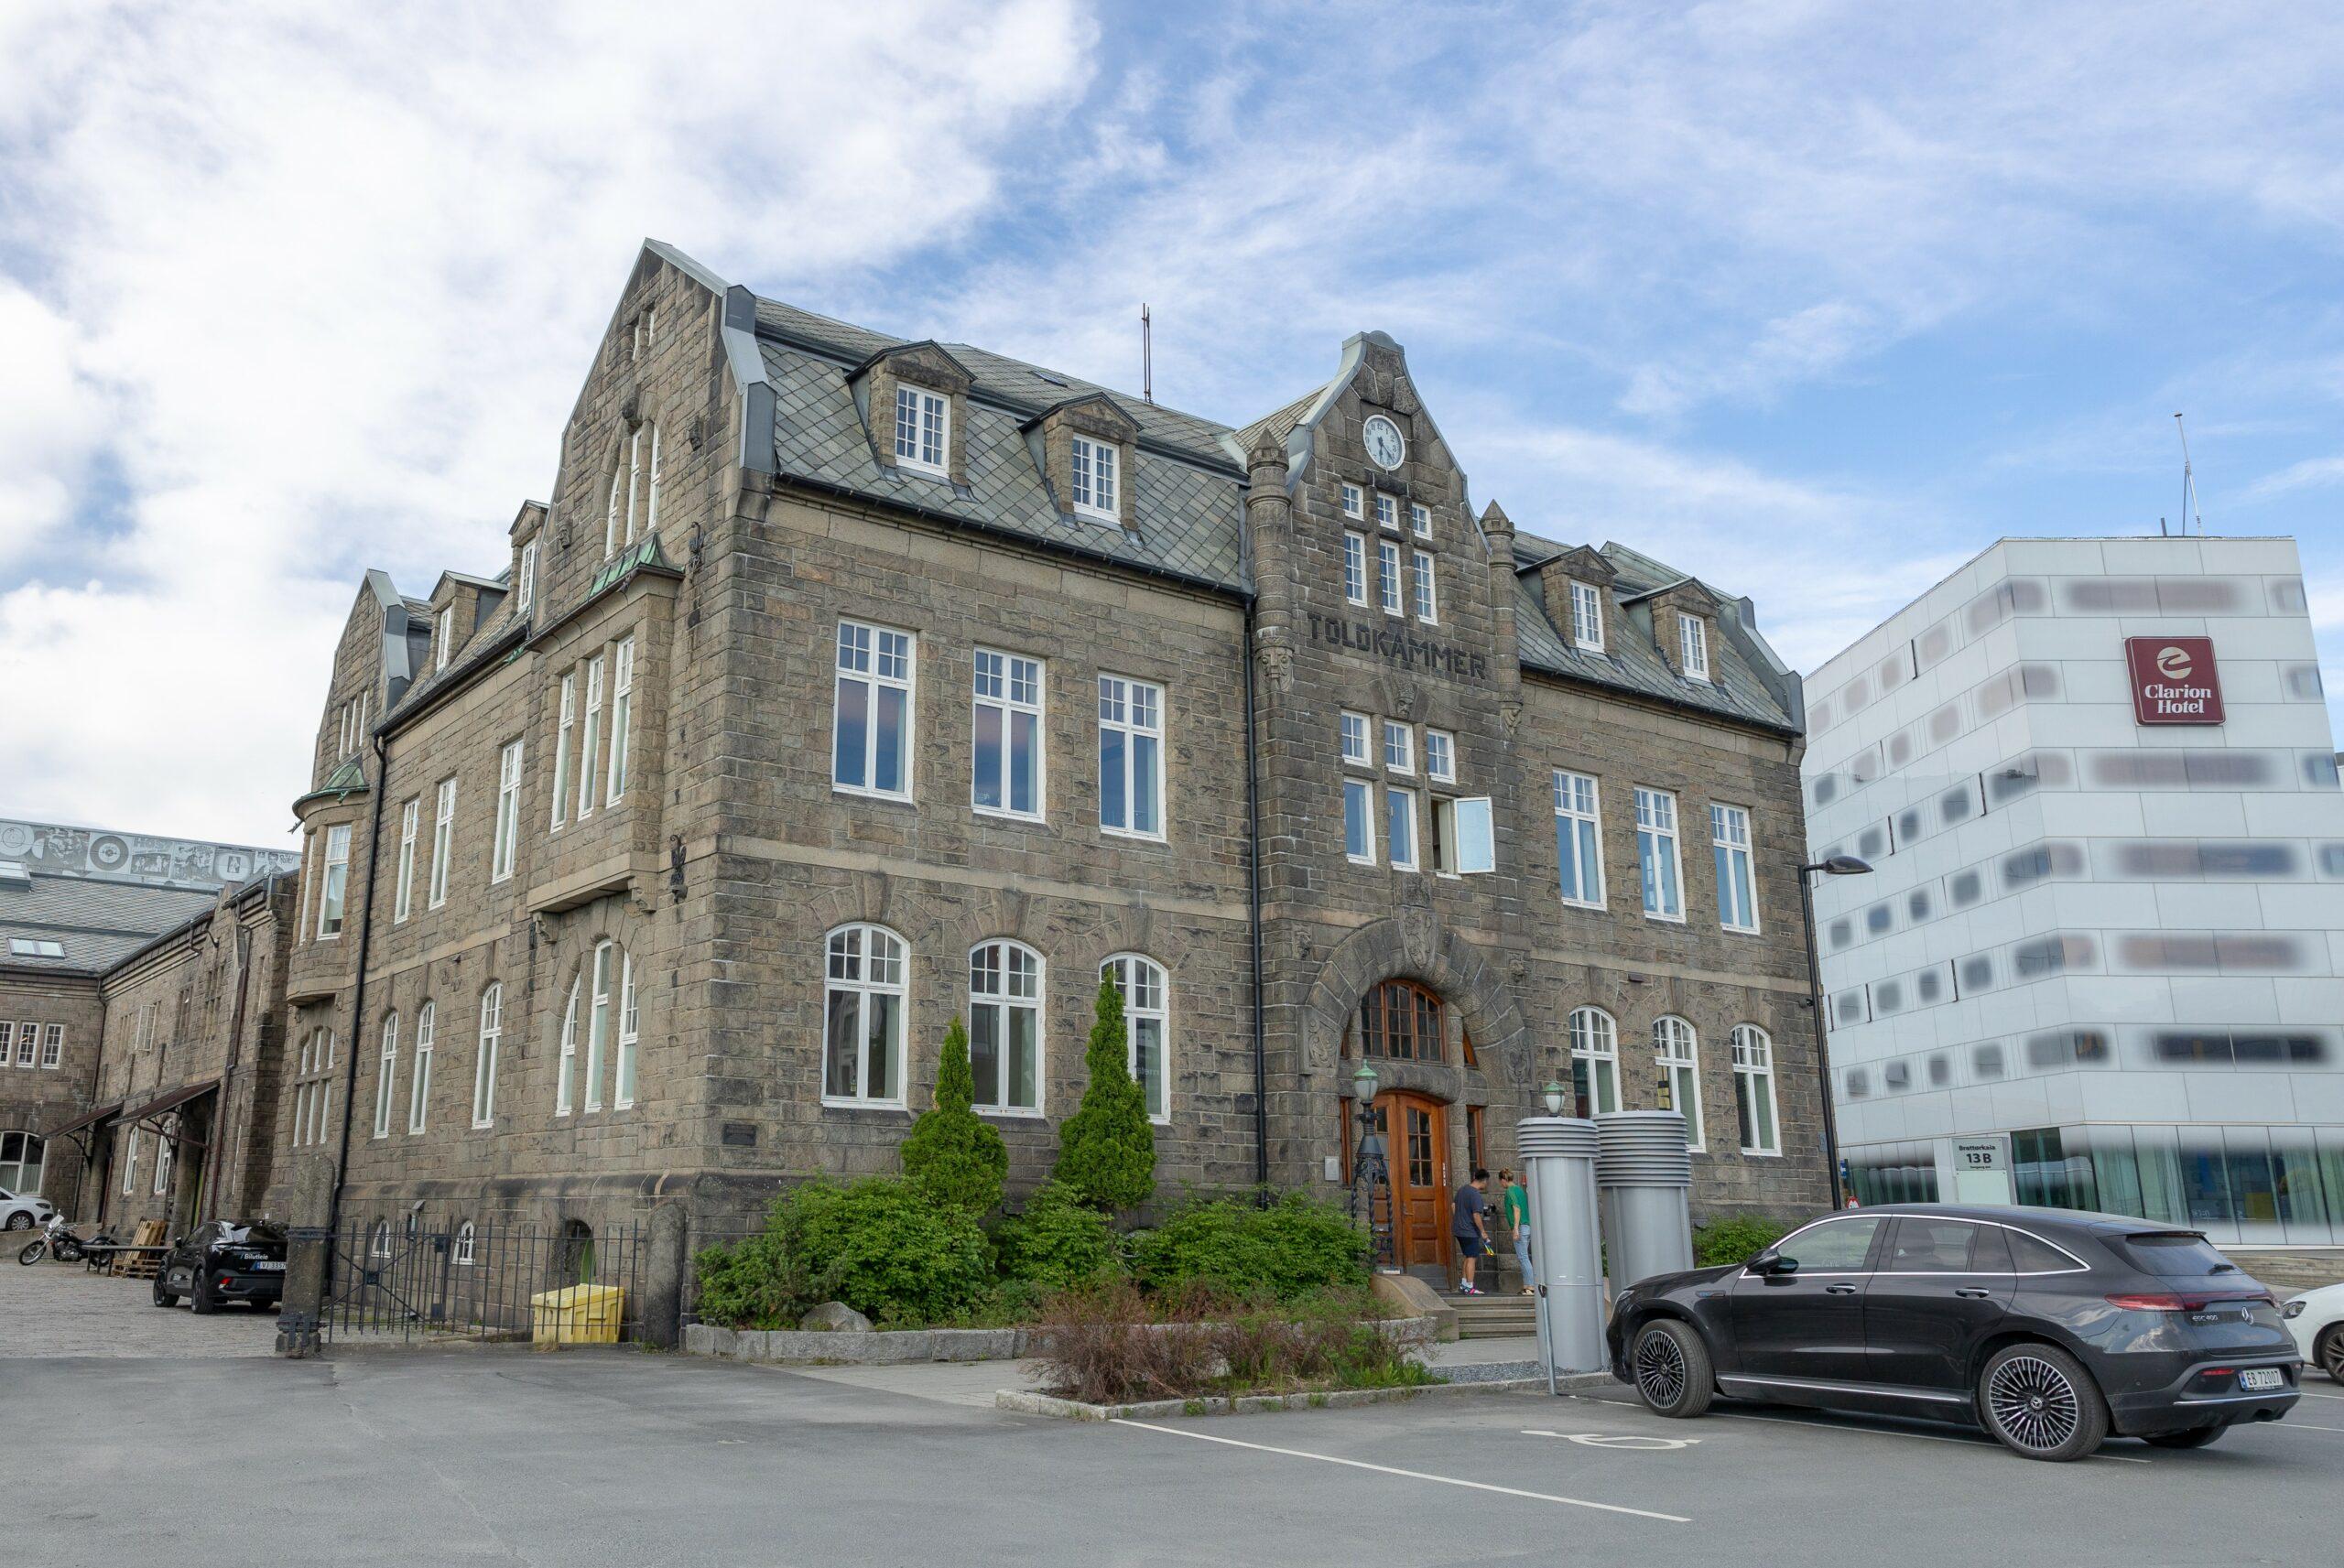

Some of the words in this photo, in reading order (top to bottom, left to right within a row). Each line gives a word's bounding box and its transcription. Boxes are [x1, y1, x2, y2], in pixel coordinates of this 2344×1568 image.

[1307, 611, 1487, 680] TOLDKAMMER
[2144, 684, 2212, 698] Clarion
[2157, 698, 2205, 714] Hotel
[1966, 1152, 1981, 1163] 13
[1982, 1152, 1992, 1163] B
[2245, 1371, 2257, 1386] EB
[2258, 1370, 2281, 1385] 72007
